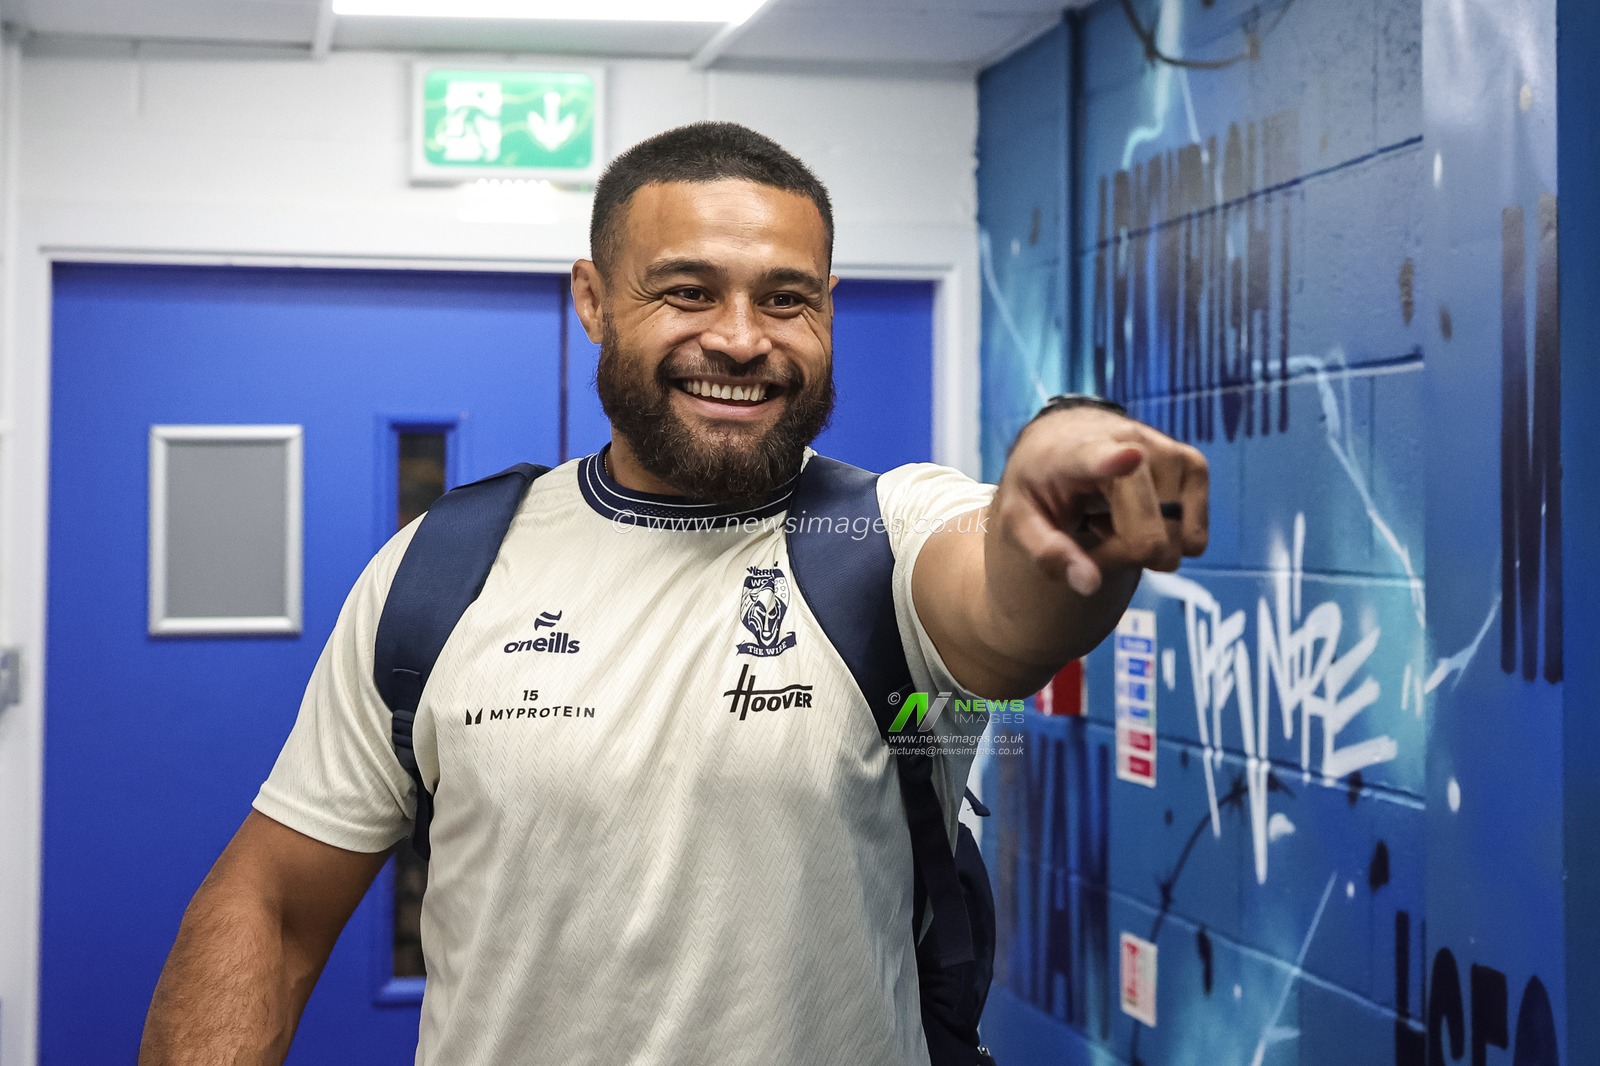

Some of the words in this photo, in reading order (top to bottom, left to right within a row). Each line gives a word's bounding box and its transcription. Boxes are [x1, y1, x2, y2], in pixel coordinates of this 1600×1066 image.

[747, 645, 764, 656] THE
[765, 641, 787, 655] WIRE
[522, 689, 539, 701] 15
[489, 705, 595, 721] MYPROTEIN
